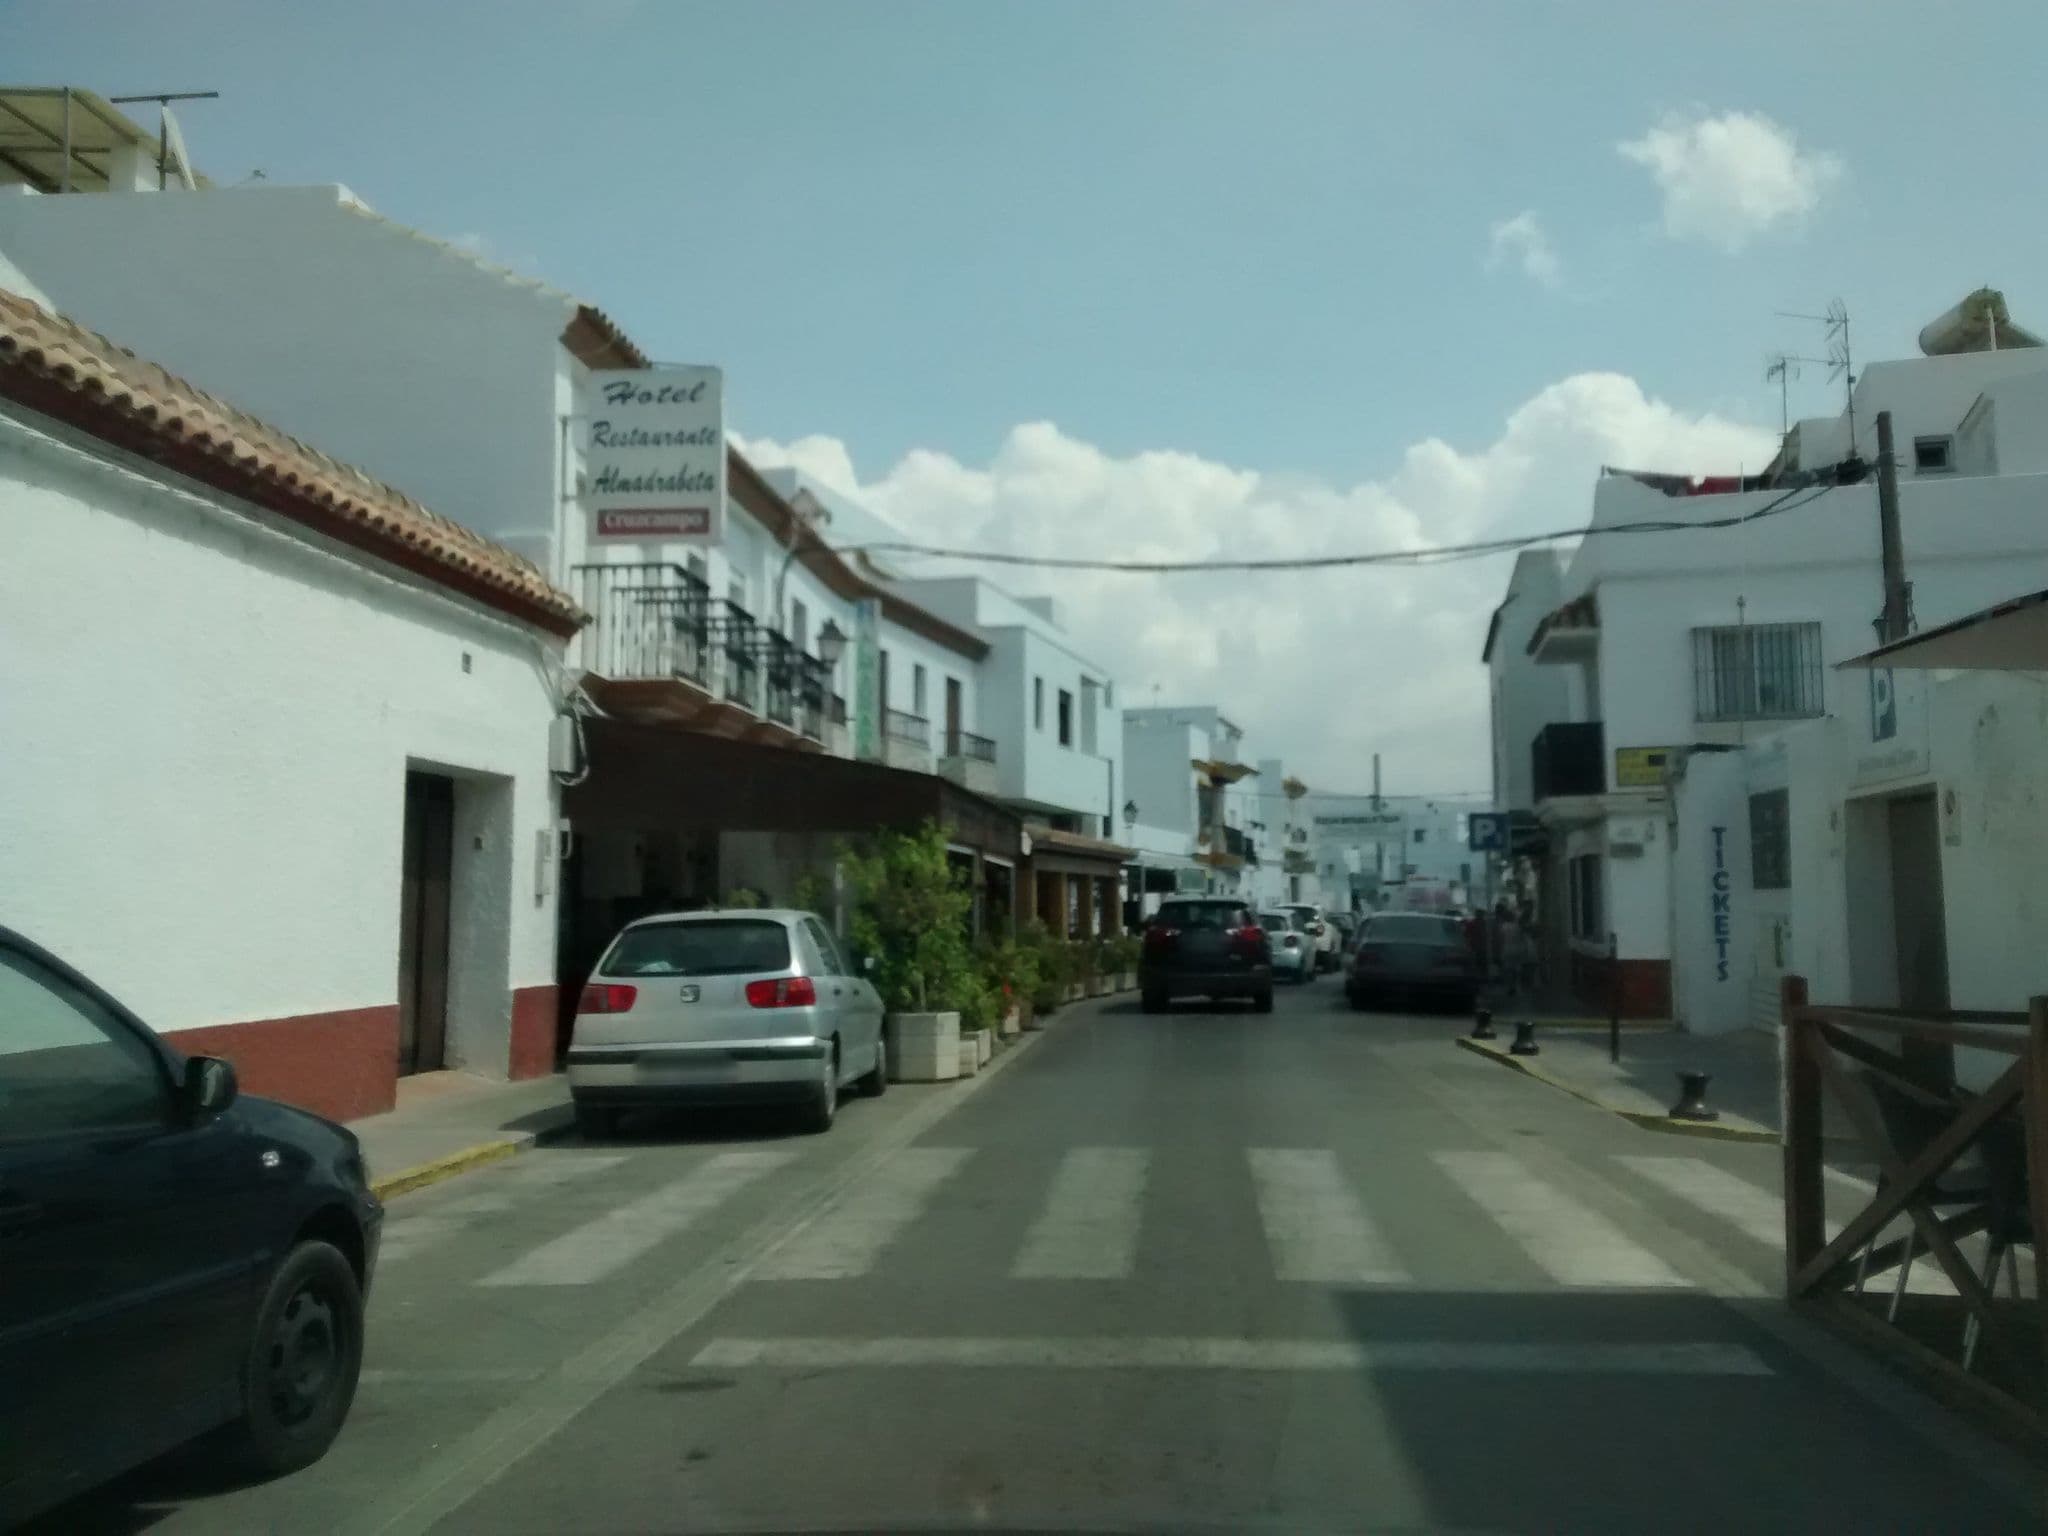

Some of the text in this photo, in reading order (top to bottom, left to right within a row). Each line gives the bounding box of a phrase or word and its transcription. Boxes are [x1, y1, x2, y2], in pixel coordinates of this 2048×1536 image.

[603, 381, 706, 405] Hotel
[592, 420, 717, 447] Restaurante
[1474, 819, 1497, 844] P
[1711, 826, 1730, 982] TICKETS
